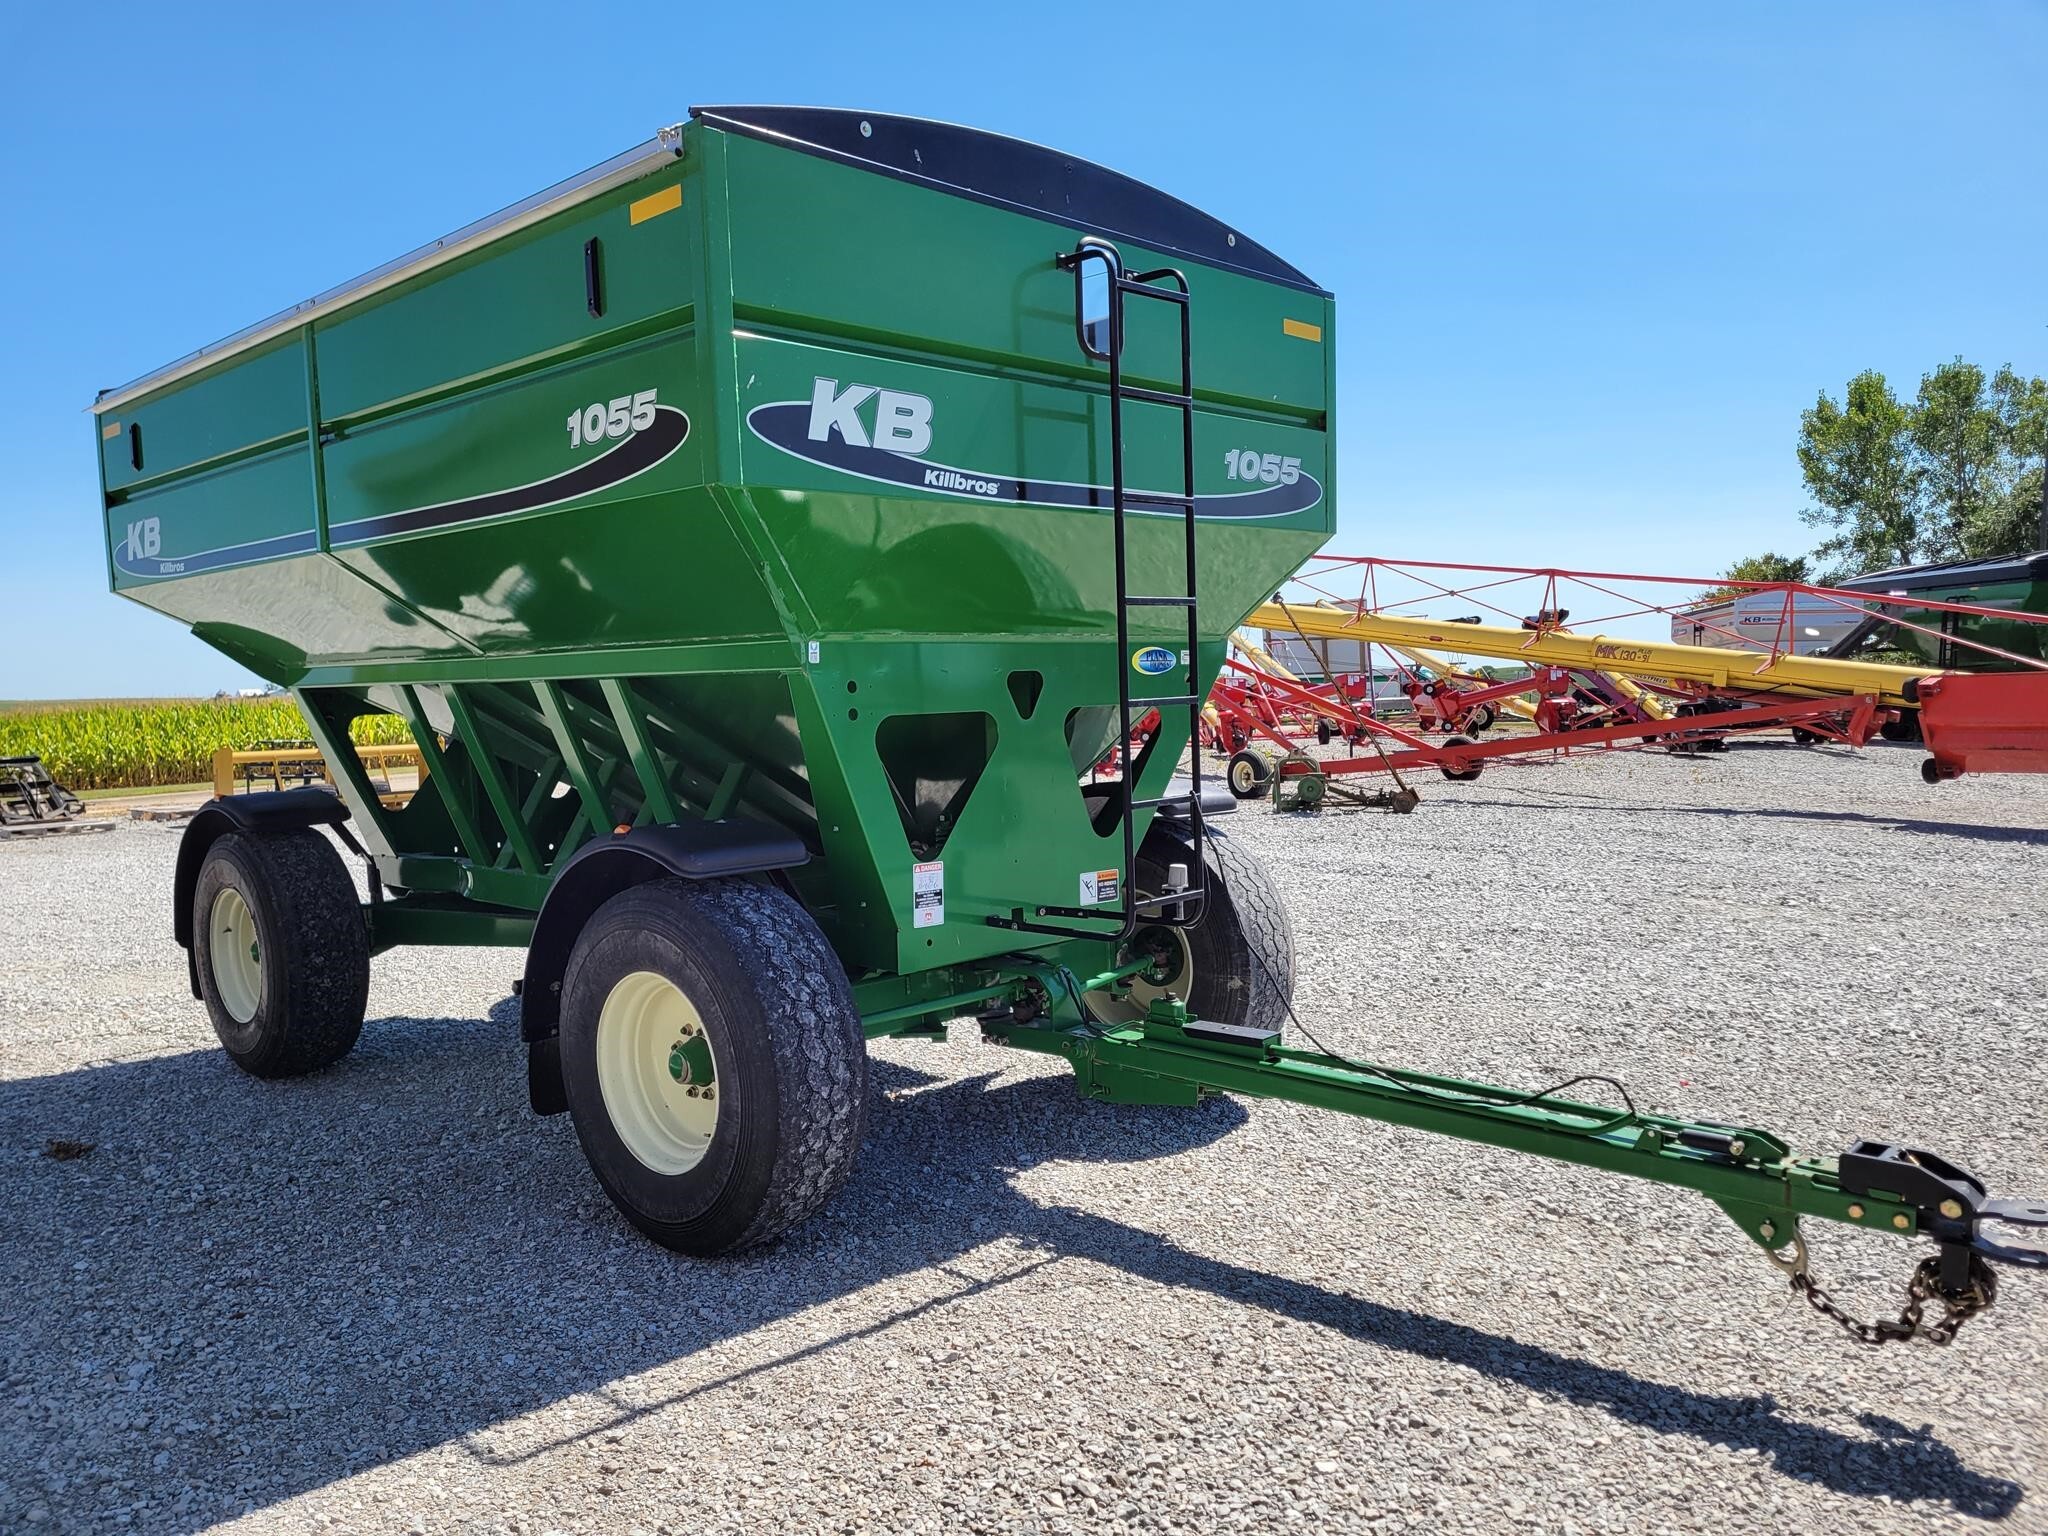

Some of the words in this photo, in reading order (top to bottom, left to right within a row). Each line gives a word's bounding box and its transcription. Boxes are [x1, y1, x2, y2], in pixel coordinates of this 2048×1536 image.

[567, 388, 657, 449] 1055
[808, 375, 934, 455] KB
[1225, 449, 1301, 484] 1055
[924, 469, 1000, 495] Killbros
[127, 516, 161, 561] KB
[160, 562, 185, 574] Killbros
[1595, 644, 1621, 659] MK
[1620, 649, 1652, 663] 130-91
[920, 863, 942, 872] DANGER
